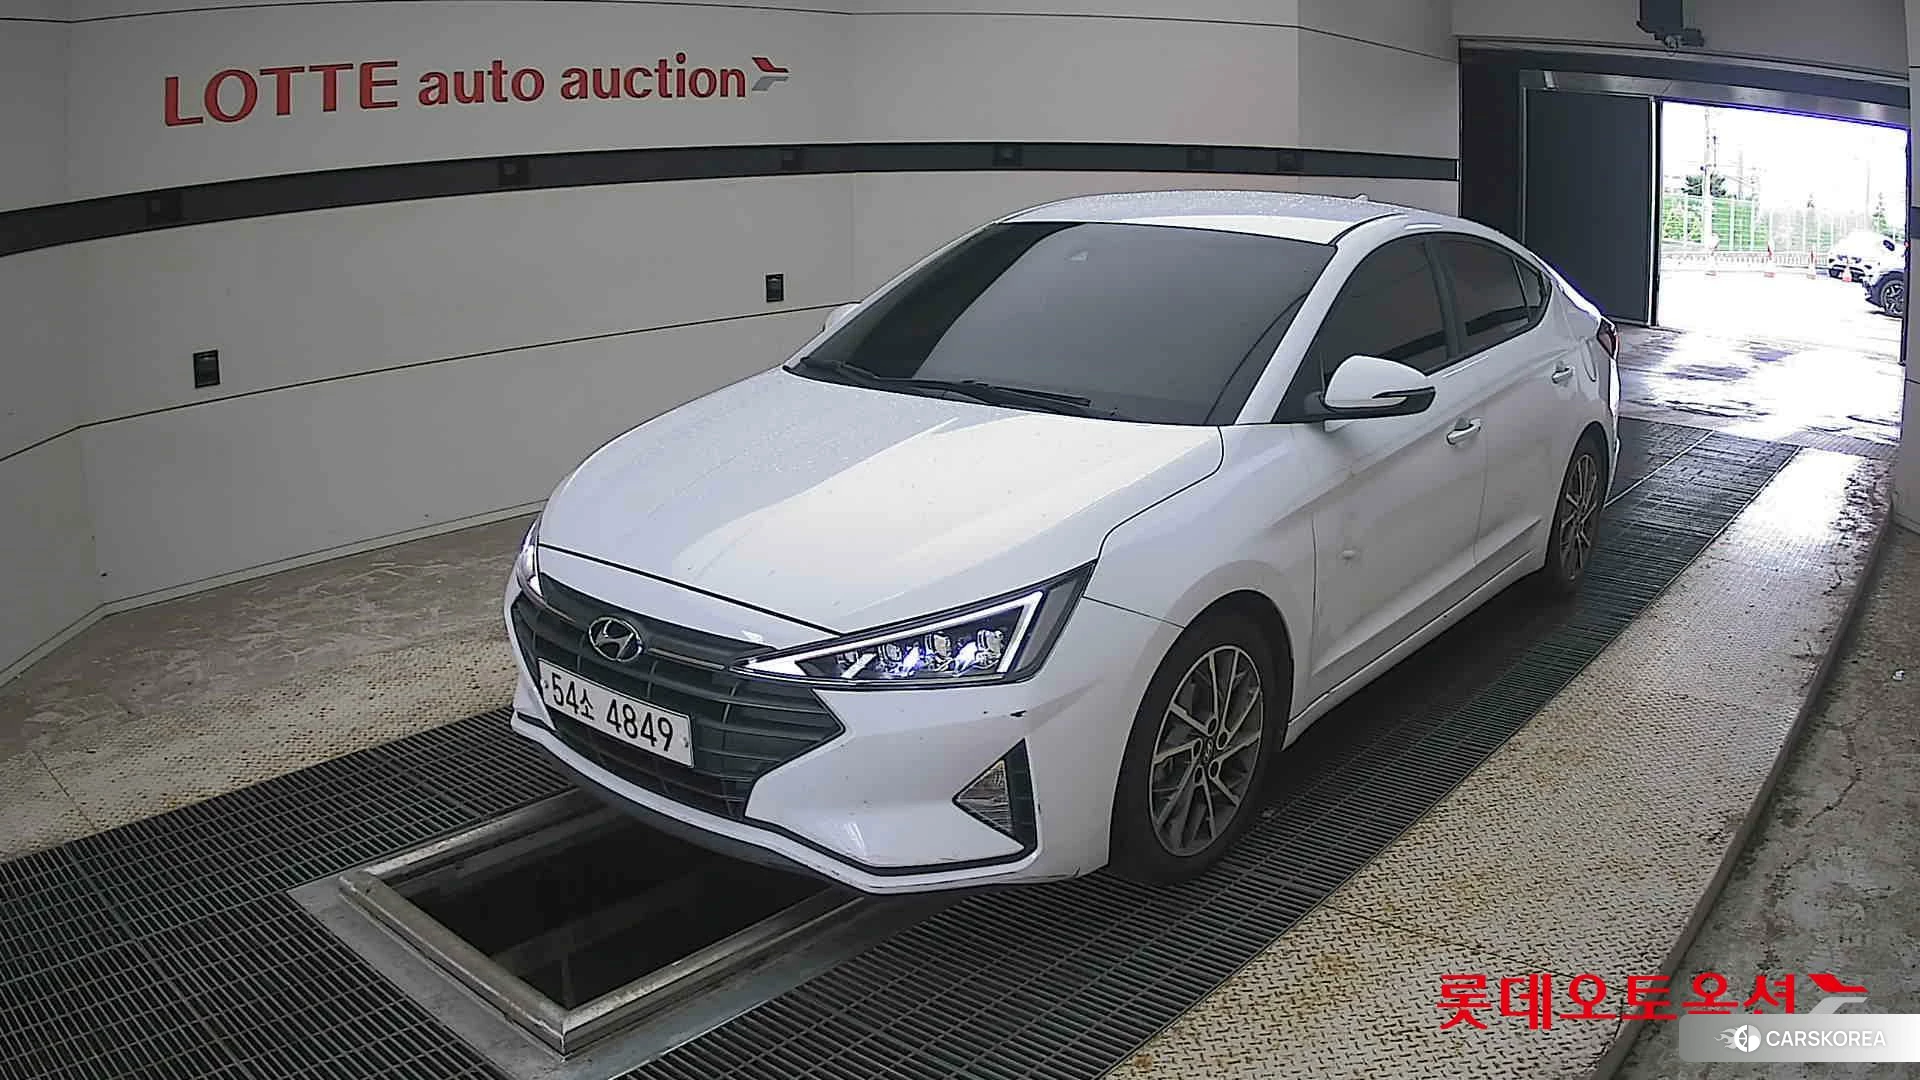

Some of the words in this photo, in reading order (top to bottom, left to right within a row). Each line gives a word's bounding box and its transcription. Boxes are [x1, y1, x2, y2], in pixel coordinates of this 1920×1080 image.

[164, 60, 399, 126] LOTTE
[418, 58, 545, 105] auto
[560, 52, 747, 100] auction
[551, 671, 595, 720] 54소
[606, 698, 674, 752] 4849
